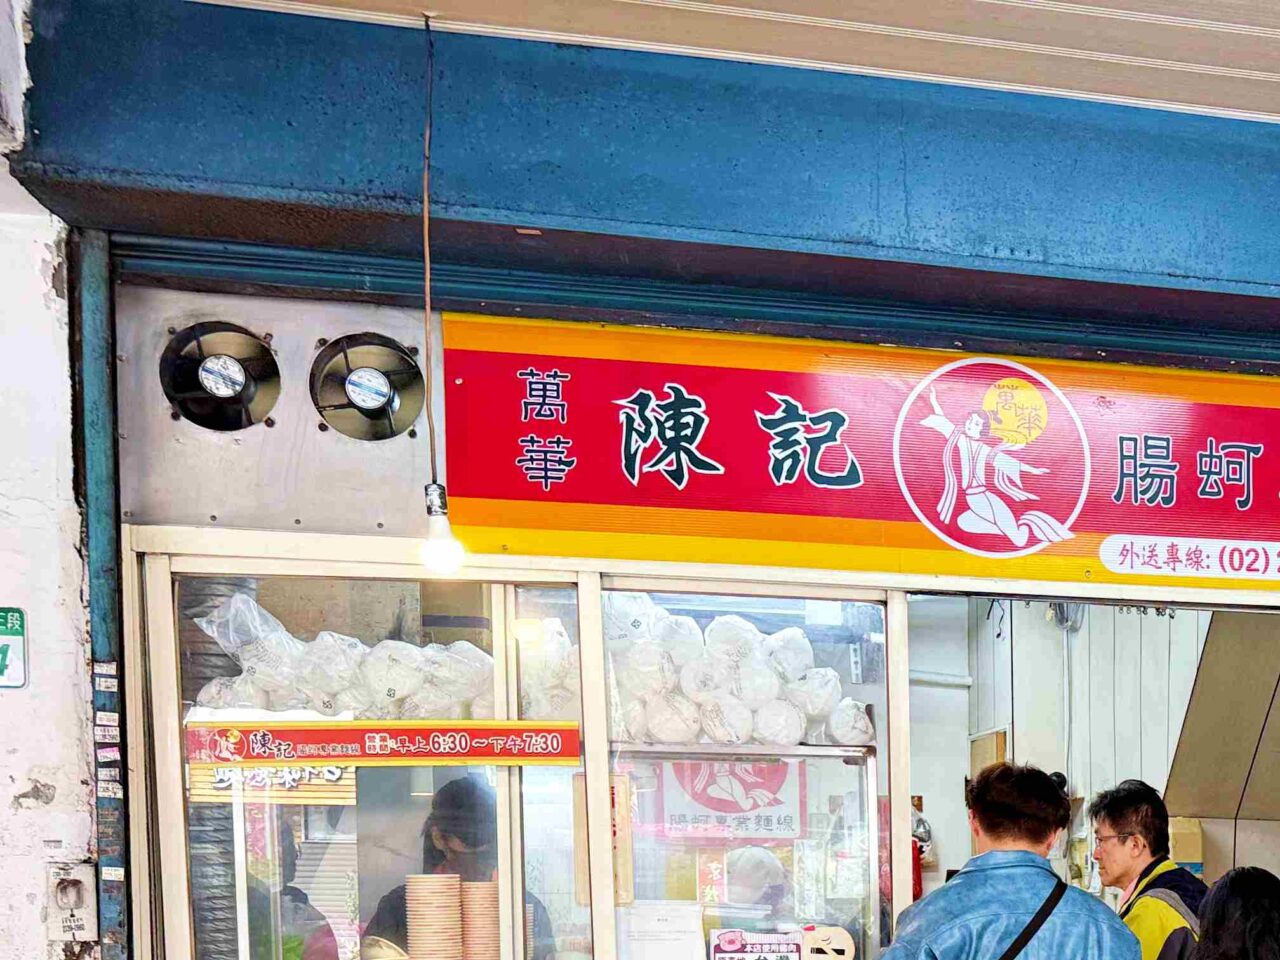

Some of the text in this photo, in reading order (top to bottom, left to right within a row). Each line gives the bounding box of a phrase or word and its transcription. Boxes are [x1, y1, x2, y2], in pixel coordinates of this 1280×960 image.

[515, 367, 576, 492] 萬華
[611, 383, 864, 490] 陳記
[1218, 548, 1269, 574] (02)
[250, 730, 296, 761] 陳記
